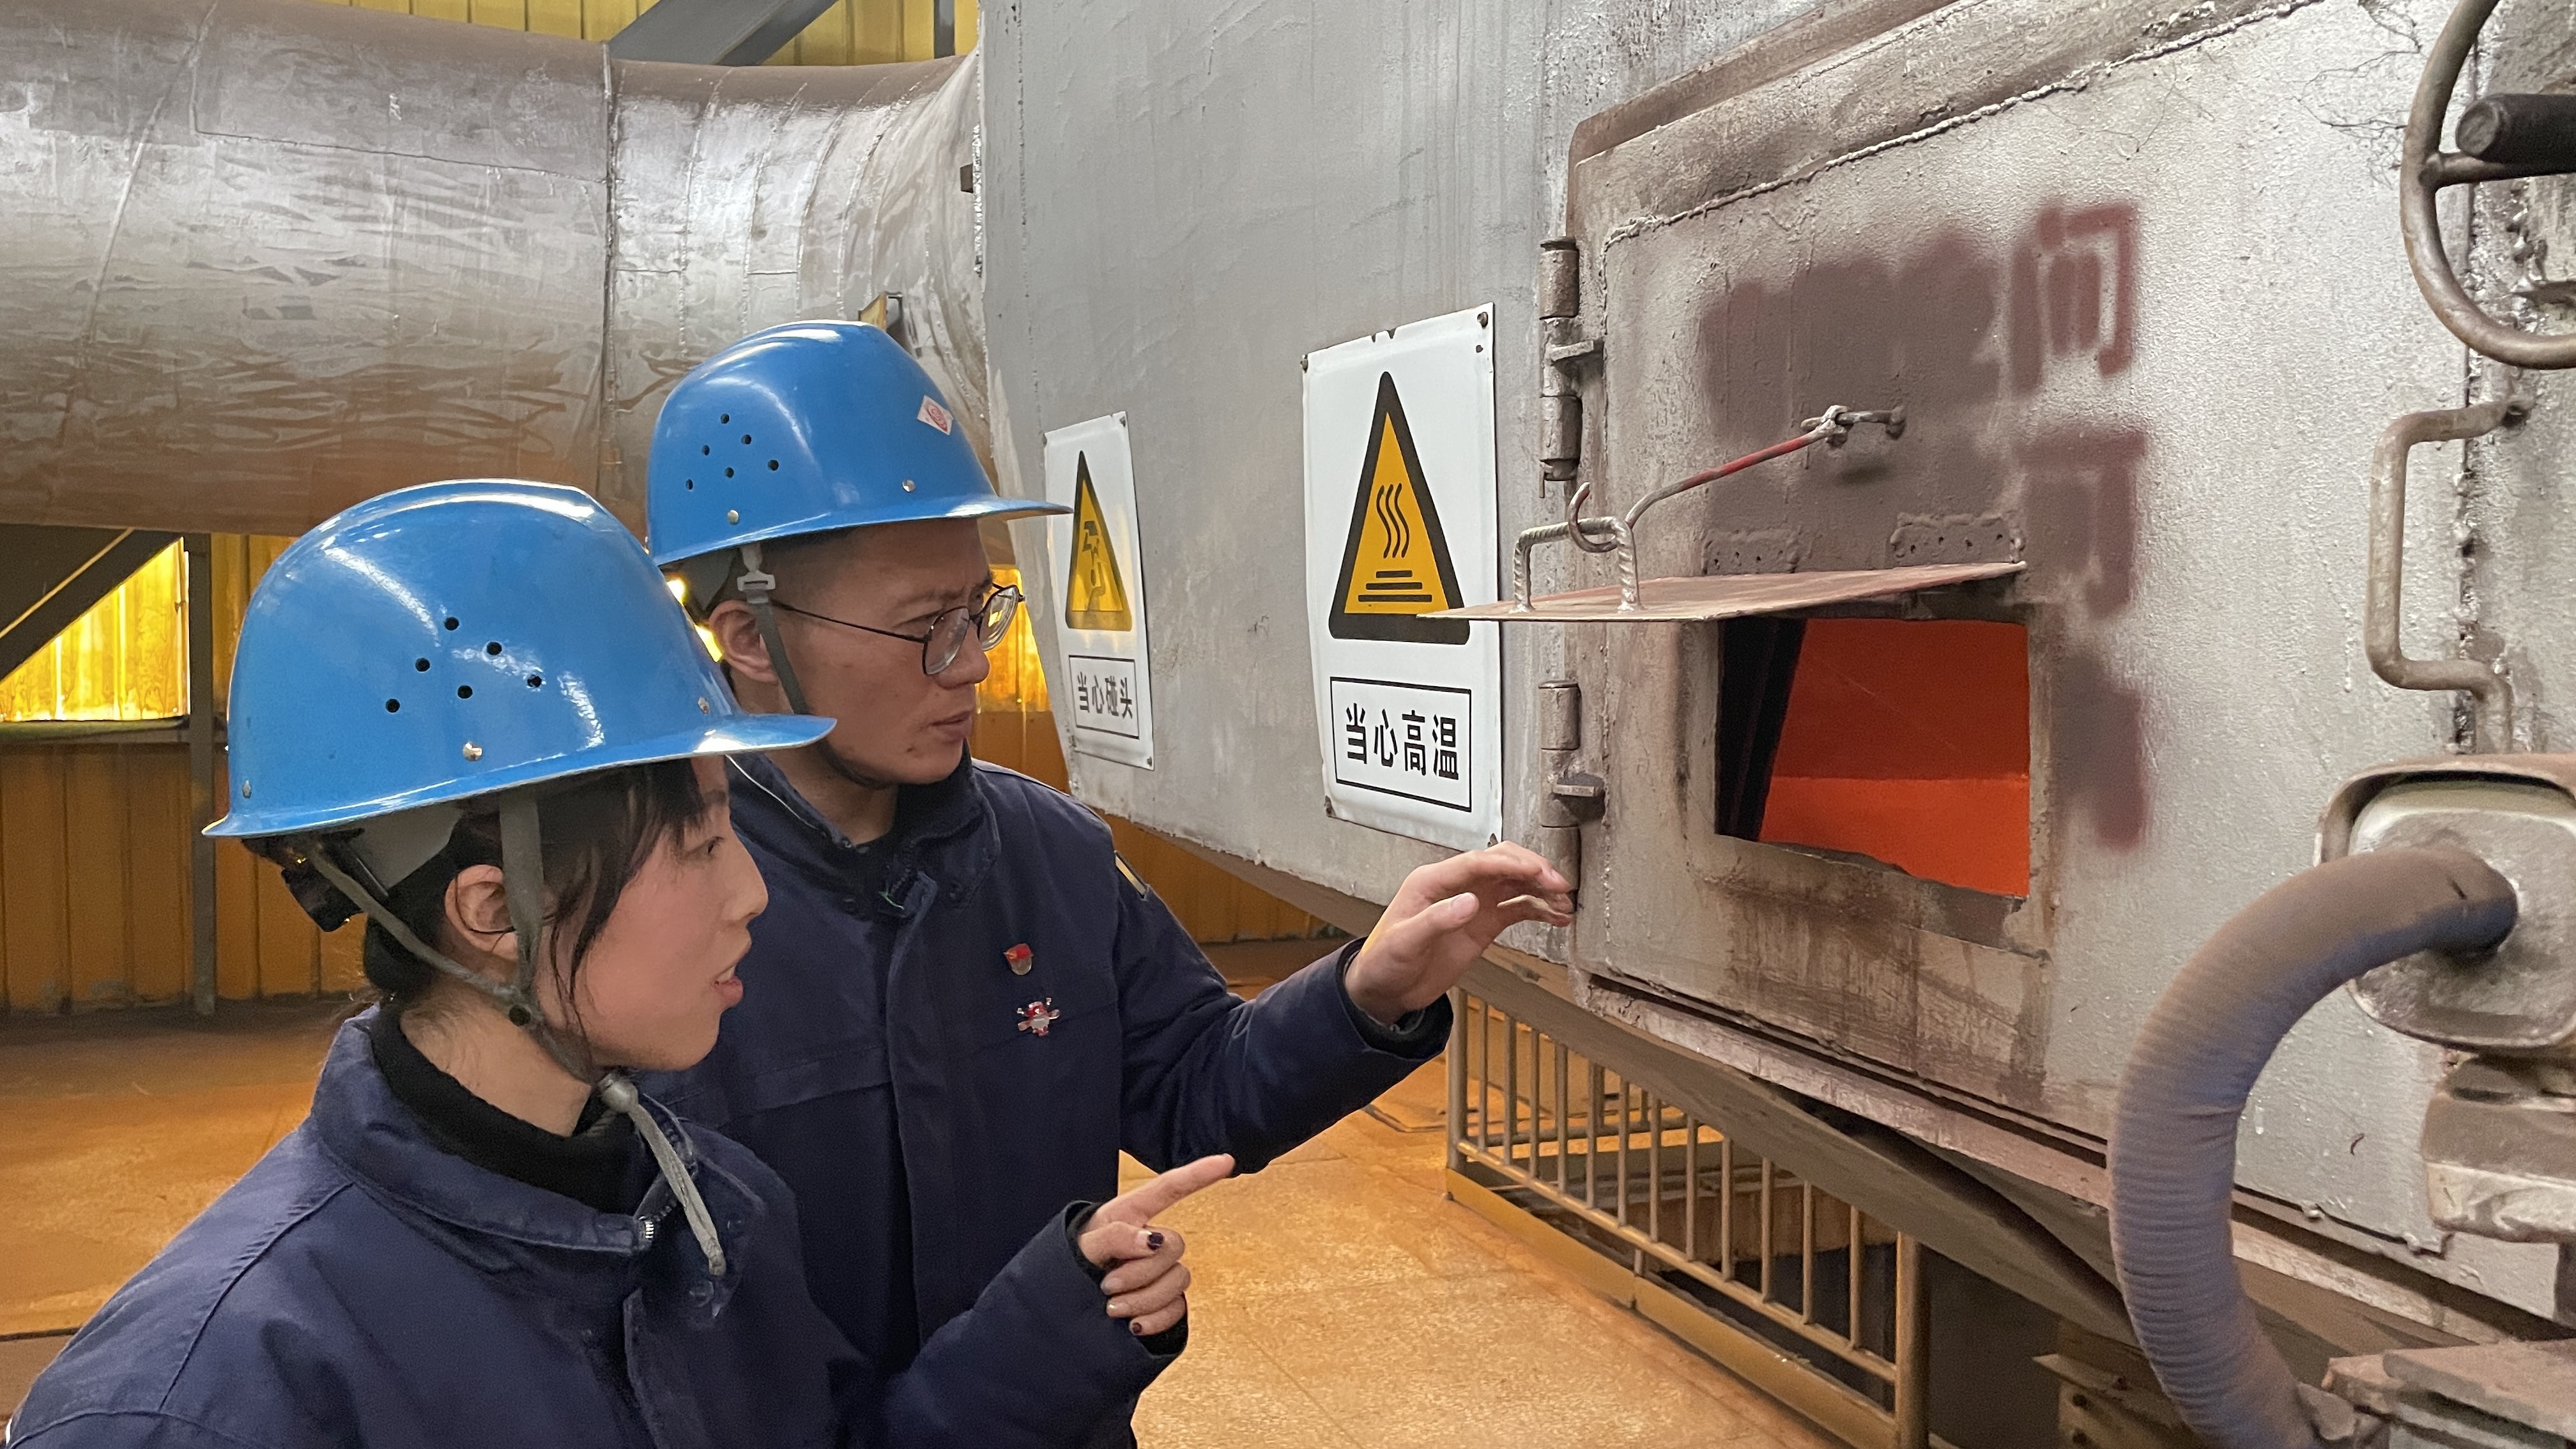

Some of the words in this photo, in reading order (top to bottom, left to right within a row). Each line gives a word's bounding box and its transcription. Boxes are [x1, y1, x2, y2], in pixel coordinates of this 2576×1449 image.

[1077, 671, 1133, 719] 当心碰头
[1346, 703, 1459, 781] 当心高温
